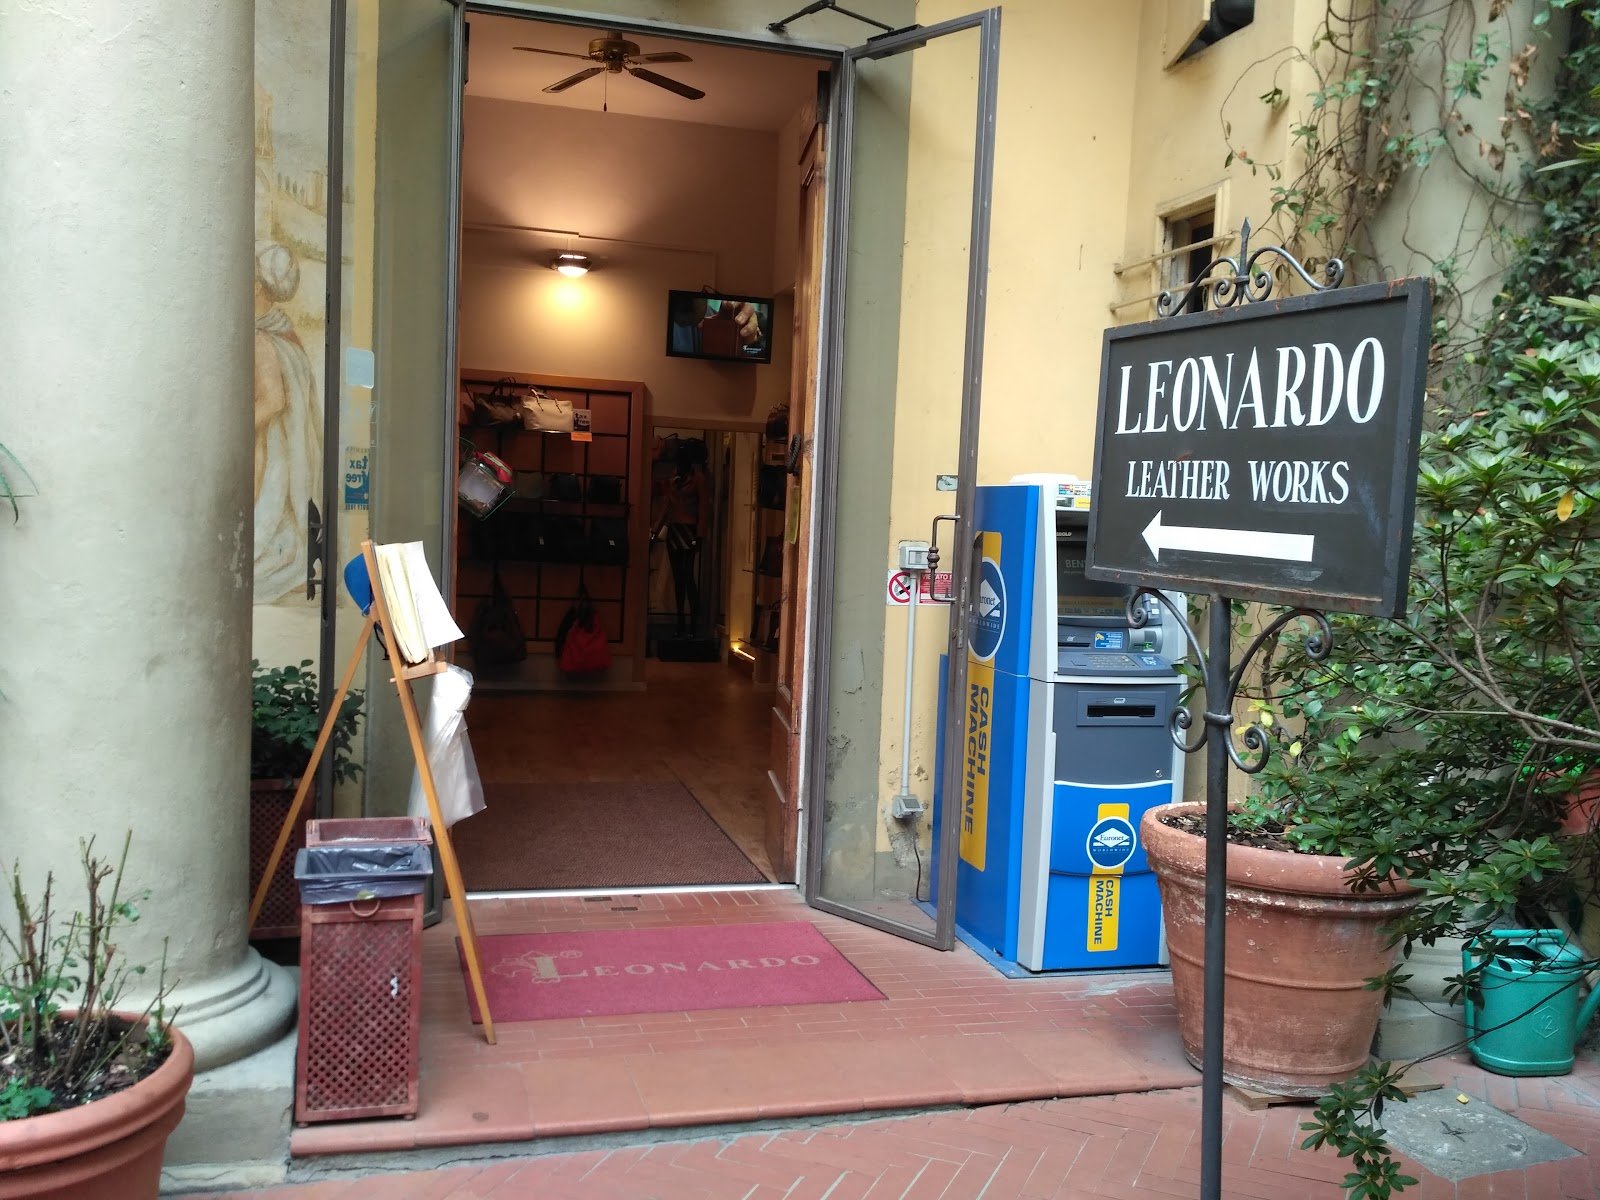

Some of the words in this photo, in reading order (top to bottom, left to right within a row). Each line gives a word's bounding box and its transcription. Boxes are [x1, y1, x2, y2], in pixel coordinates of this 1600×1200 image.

[1114, 337, 1385, 435] LEONARDO
[1125, 460, 1230, 501] LEATHER
[1247, 460, 1350, 505] WORKS
[921, 573, 949, 581] VIEATO
[977, 686, 989, 776] CASH
[964, 683, 979, 835] MACHINE
[1093, 880, 1105, 945] MACHINE
[1104, 879, 1114, 917] CASH
[529, 953, 821, 985] LEONARDO
